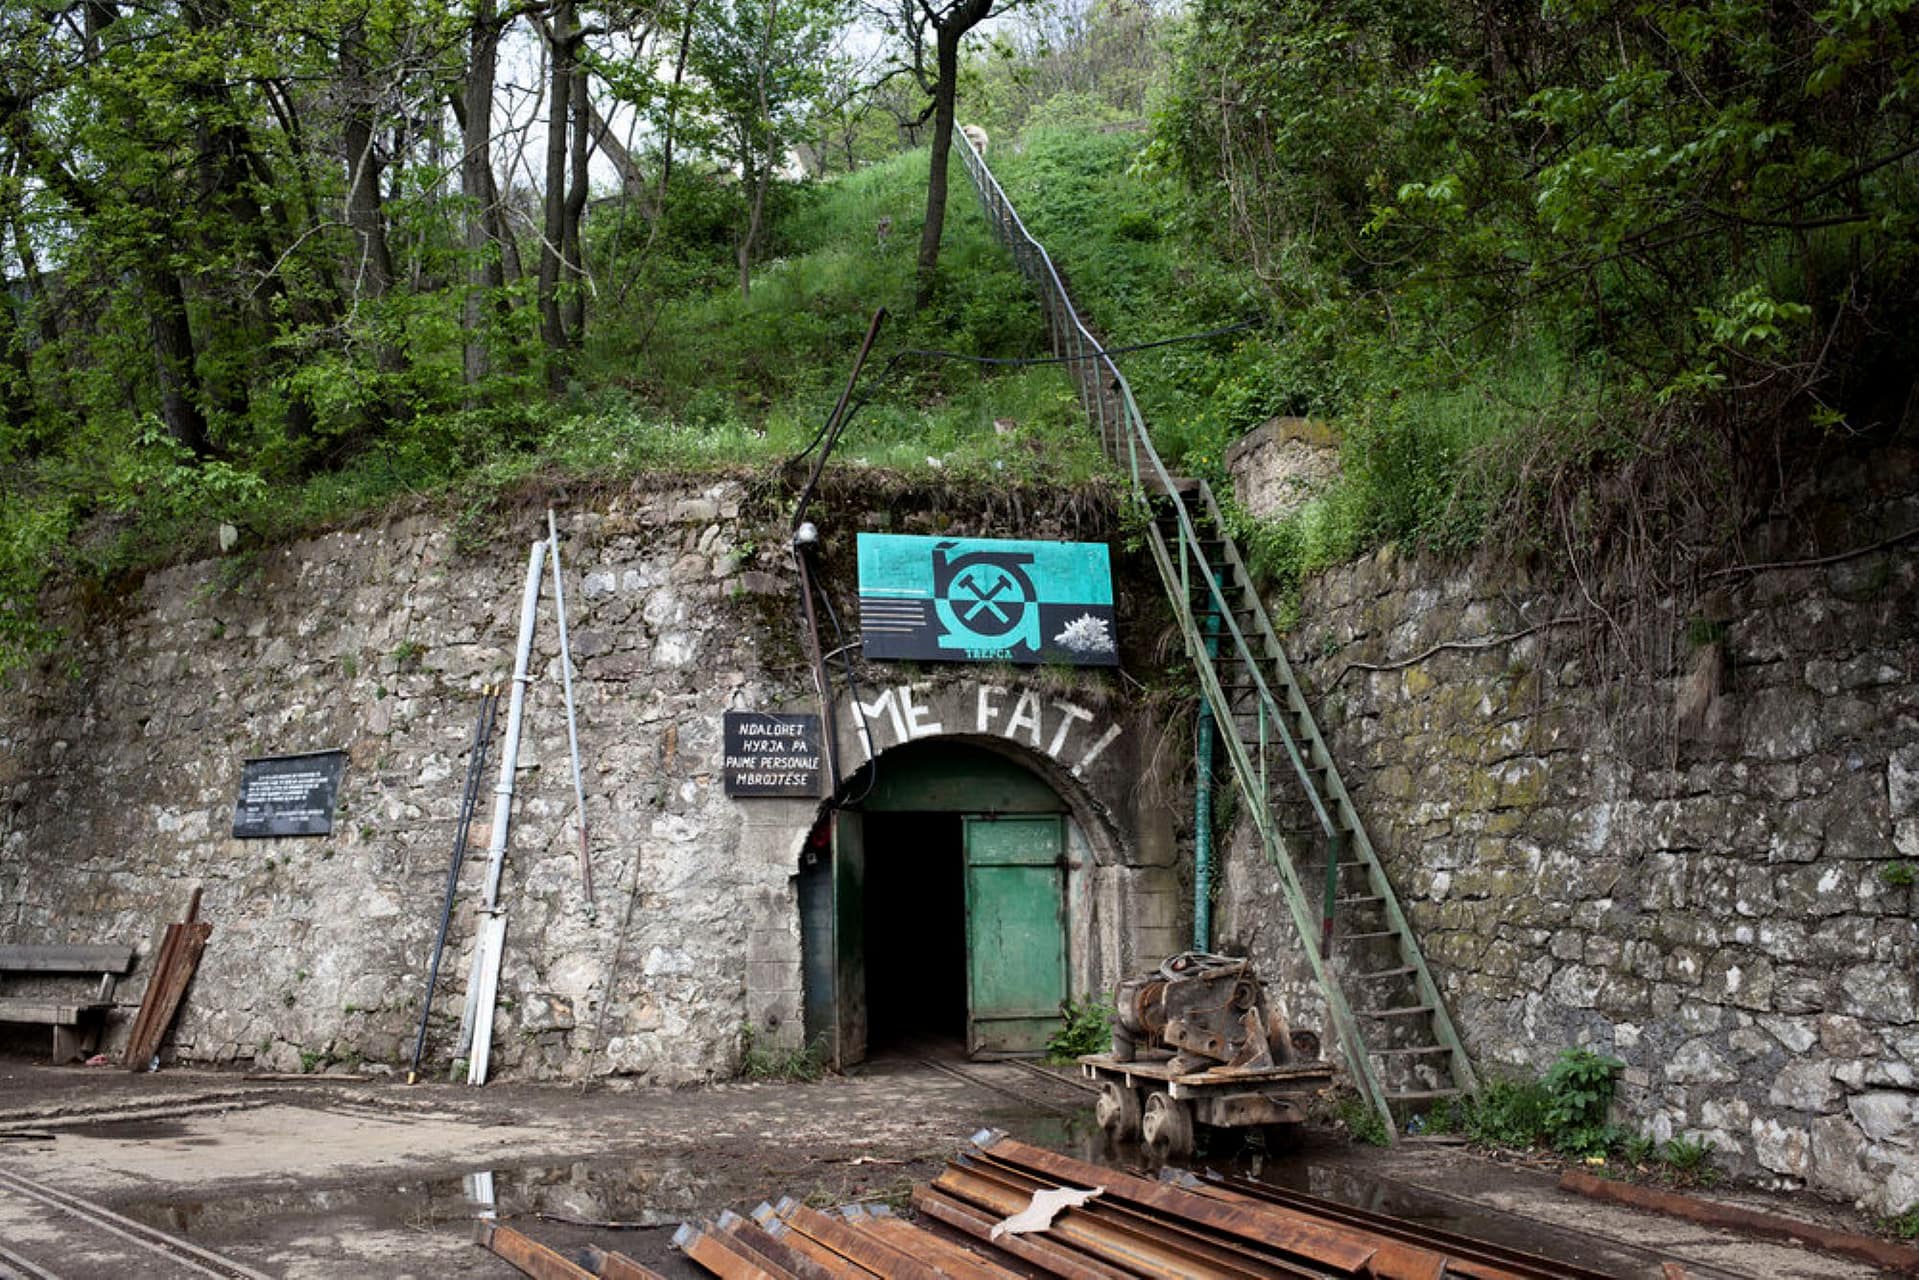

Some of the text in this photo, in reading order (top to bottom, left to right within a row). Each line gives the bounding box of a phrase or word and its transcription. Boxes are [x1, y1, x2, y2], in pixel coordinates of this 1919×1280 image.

[739, 723, 805, 736] NDALOHET
[851, 684, 1122, 777] ME FAT!
[743, 740, 808, 752] HYRJA PA
[760, 757, 820, 770] PERSONALE
